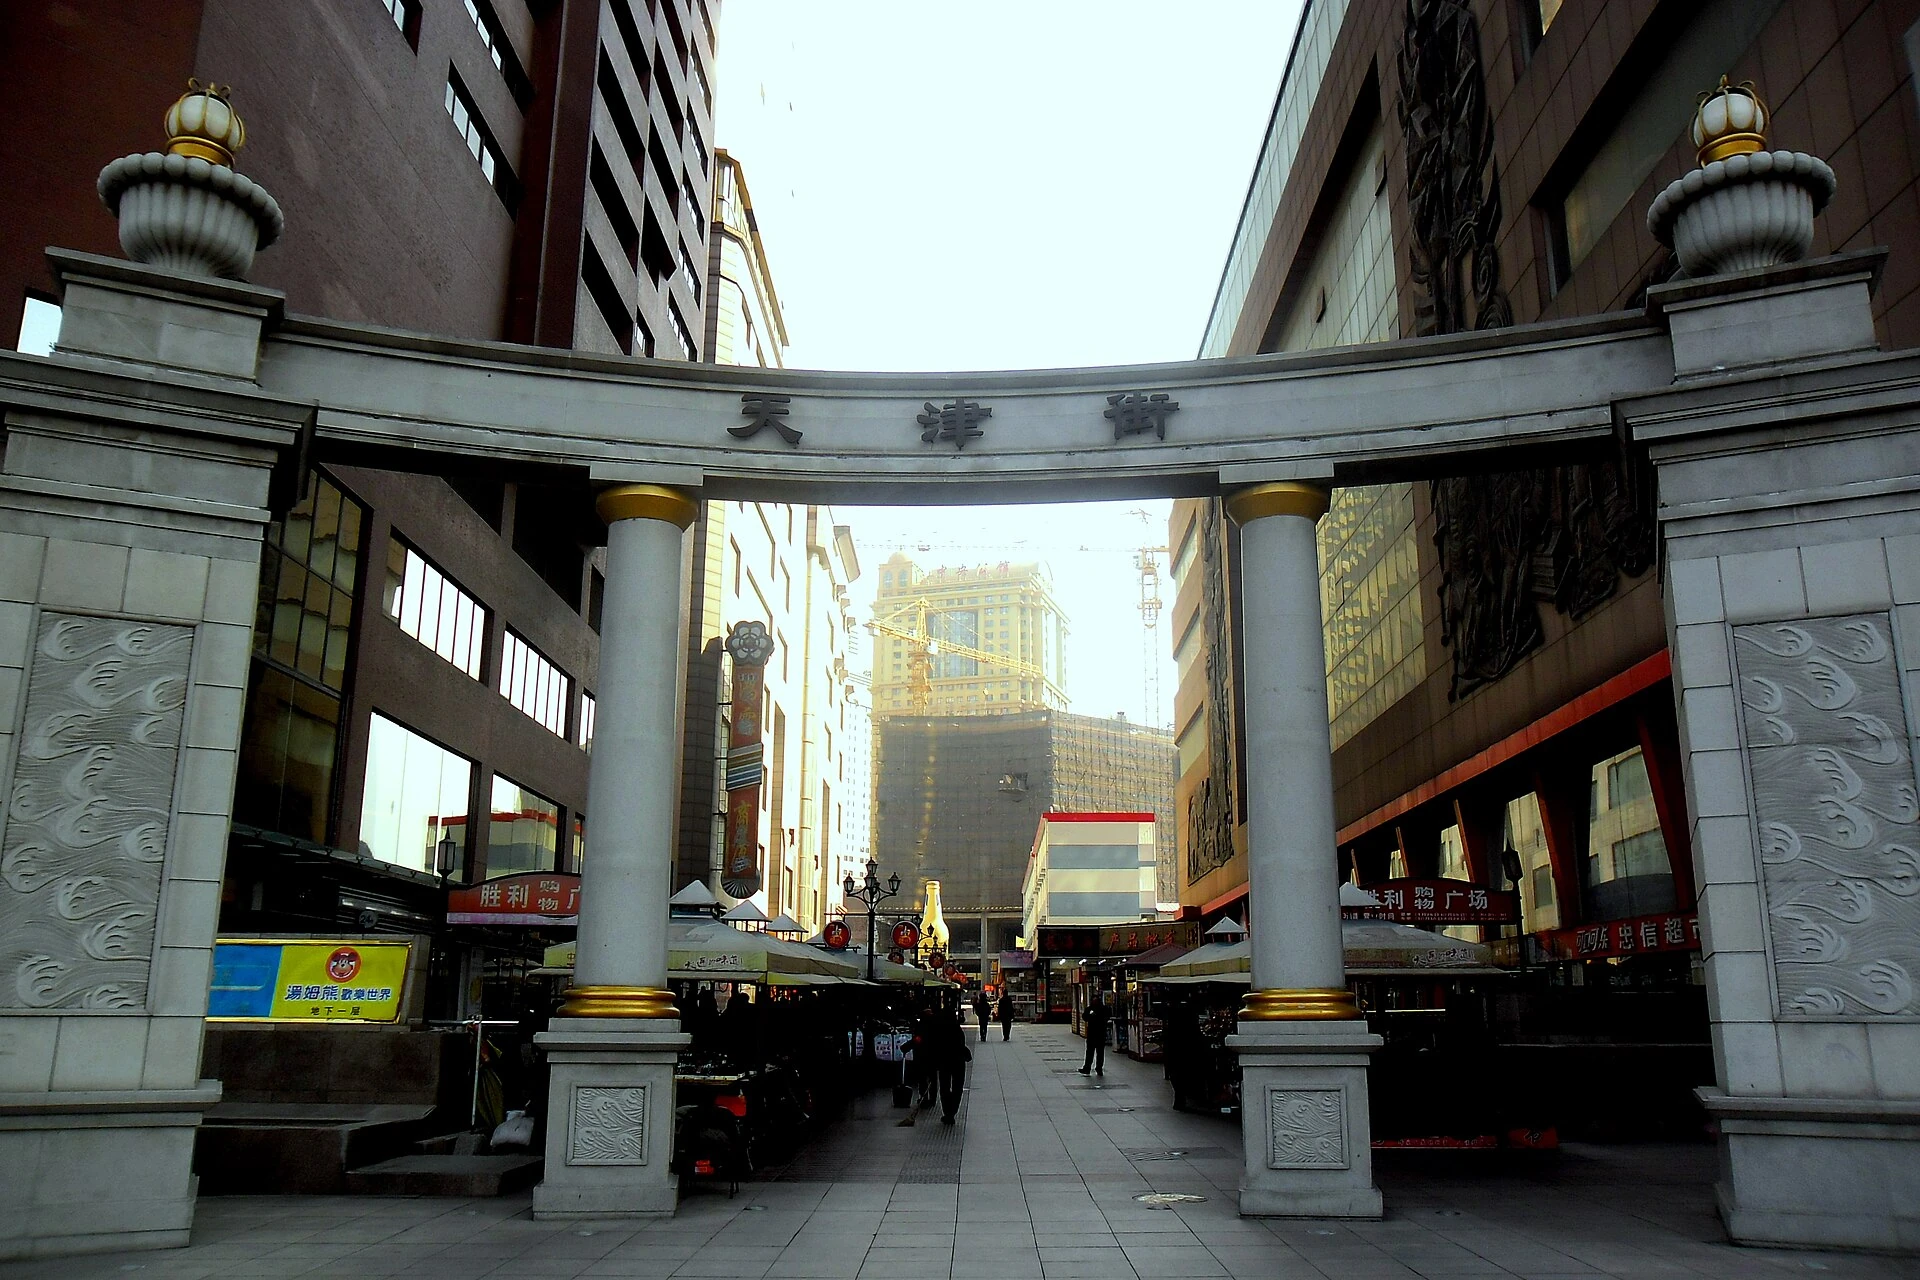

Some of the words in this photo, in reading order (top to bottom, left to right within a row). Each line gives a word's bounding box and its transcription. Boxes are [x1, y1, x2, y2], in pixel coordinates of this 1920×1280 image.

[727, 391, 1179, 451] 天津街
[310, 1006, 361, 1016] 地下一层
